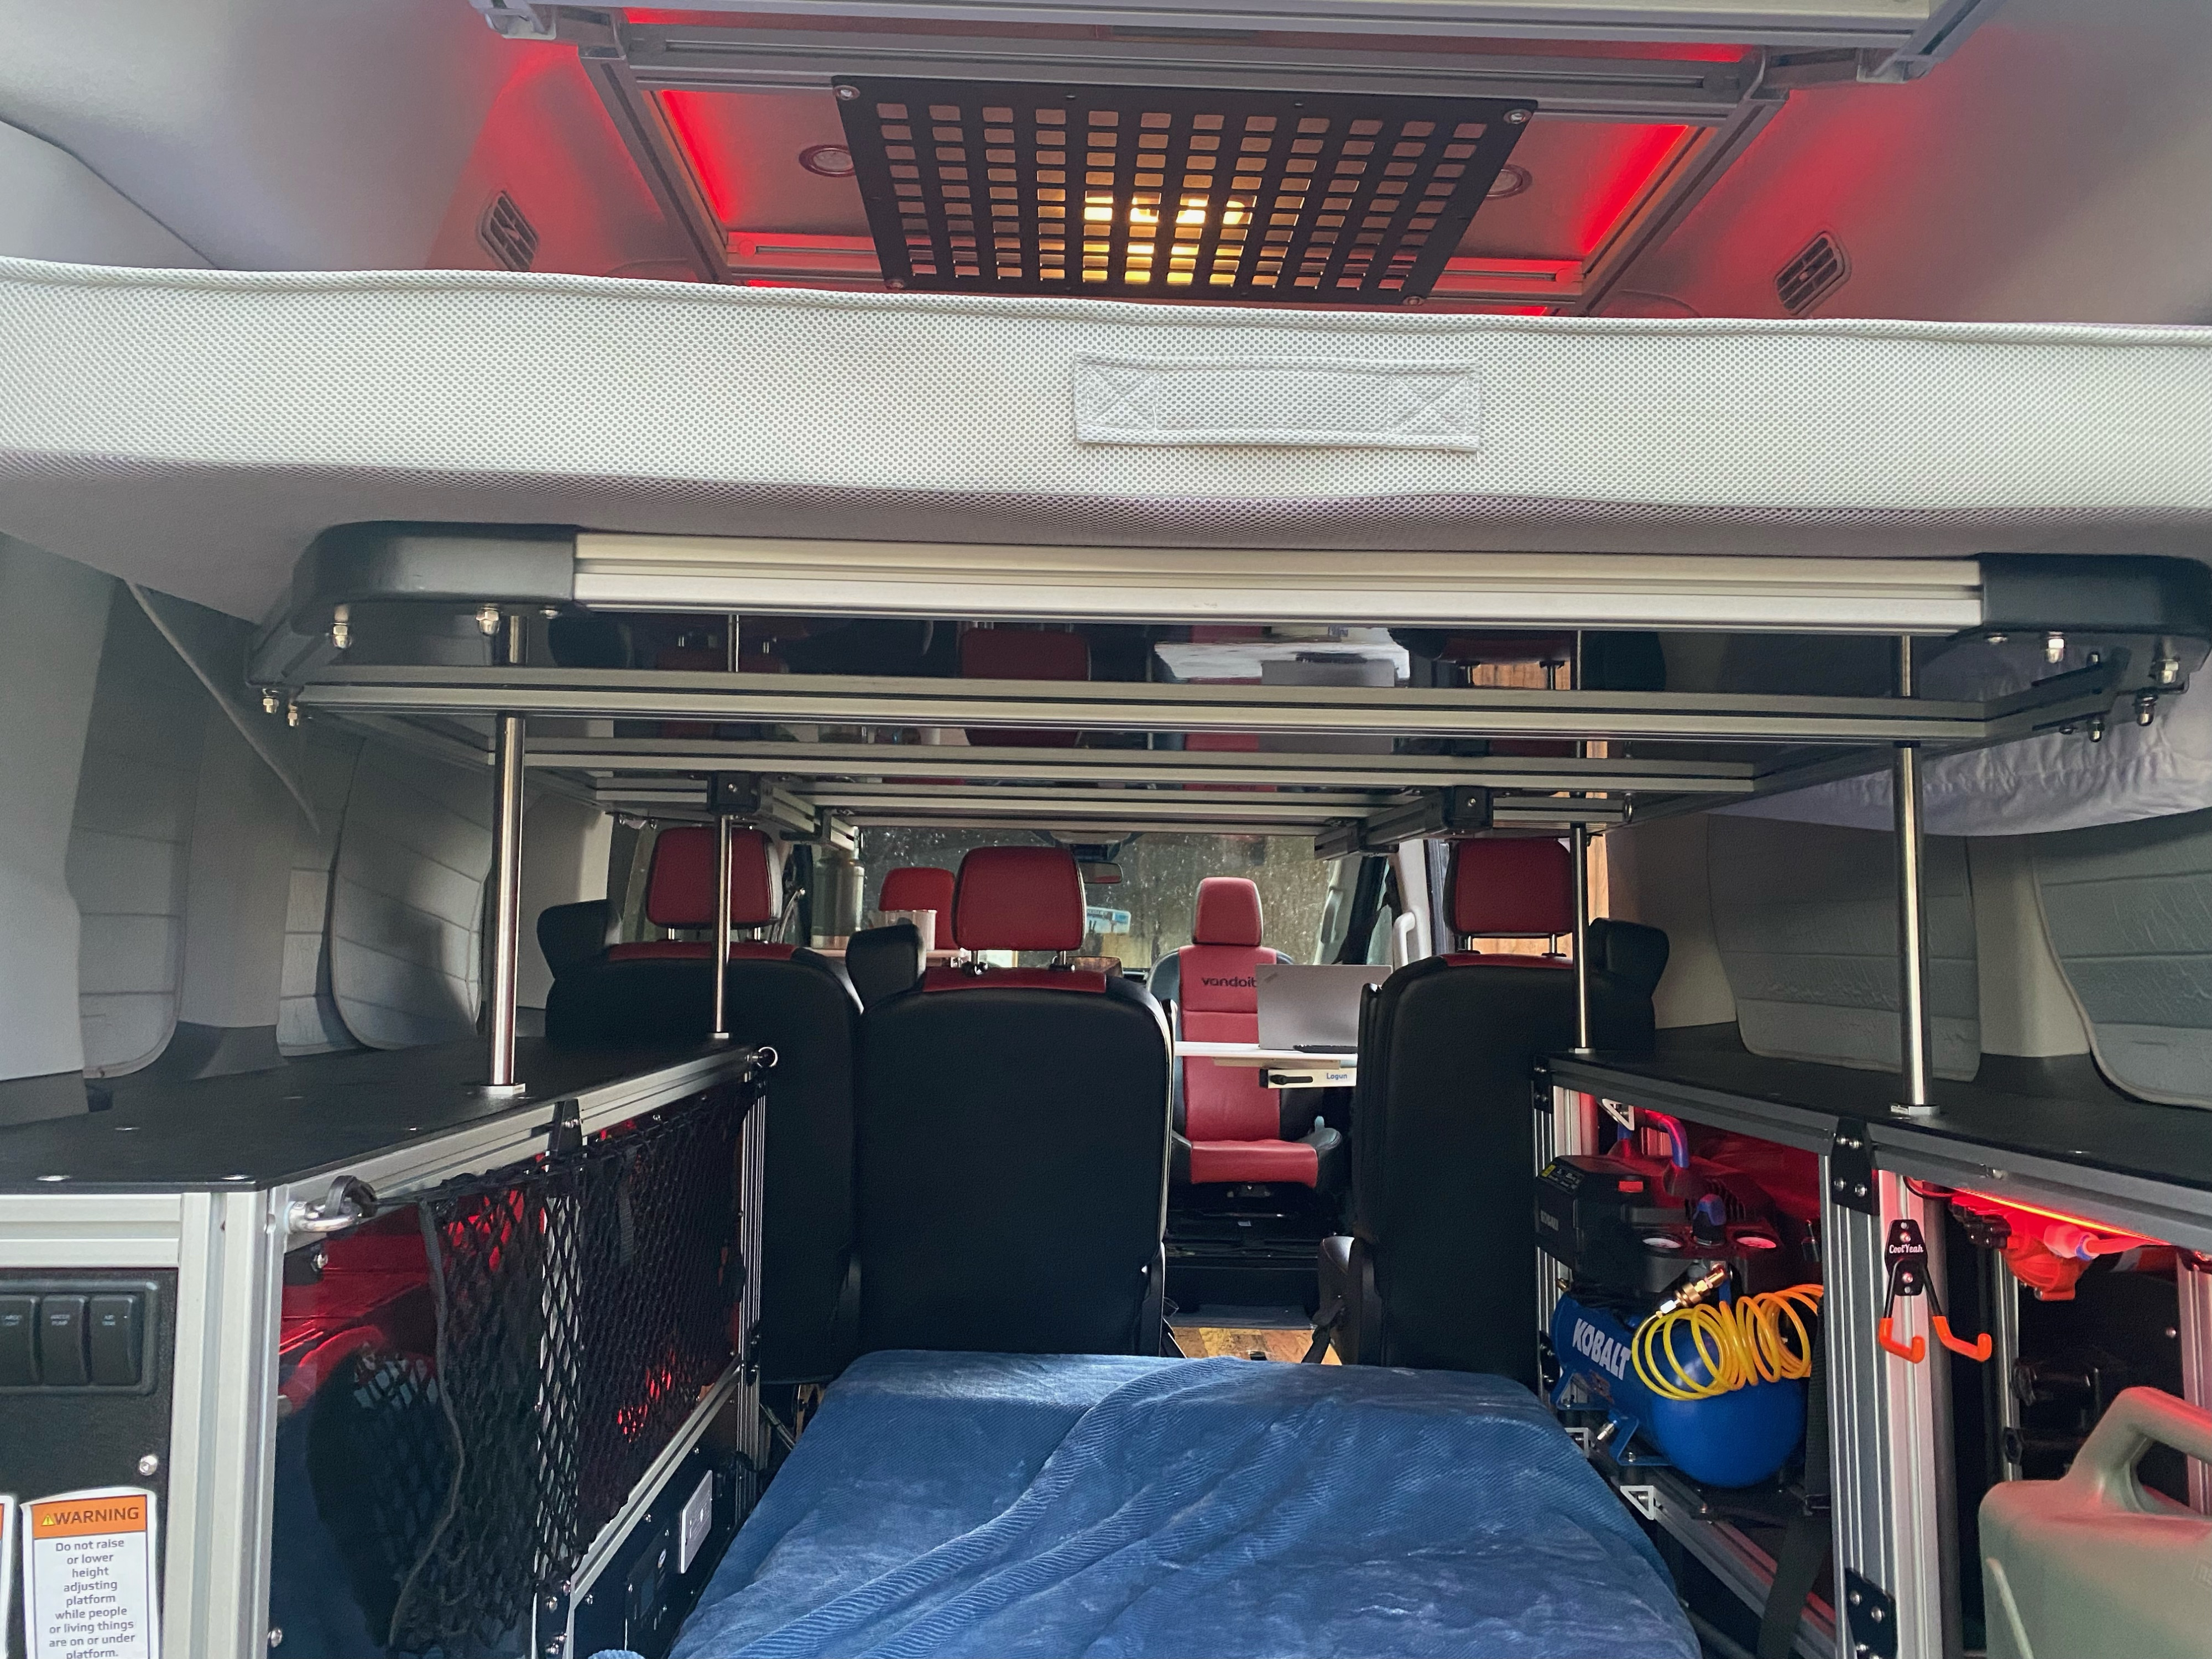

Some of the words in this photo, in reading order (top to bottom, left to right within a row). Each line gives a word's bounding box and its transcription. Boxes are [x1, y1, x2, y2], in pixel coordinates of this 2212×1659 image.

[1201, 977, 1257, 987] vandoit
[1889, 1244, 1924, 1254] CoolYeah
[1572, 1318, 1631, 1380] KOBALT
[54, 1507, 139, 1525] WARNING
[55, 1542, 71, 1552] Do
[74, 1541, 93, 1550] not
[96, 1539, 124, 1549] raise
[81, 1554, 114, 1564] lower
[72, 1566, 109, 1579] height
[64, 1580, 118, 1594] adjusting
[66, 1594, 116, 1608] platform
[55, 1609, 86, 1620] while
[88, 1606, 127, 1620] people
[64, 1623, 95, 1634] living
[97, 1620, 134, 1631] things
[70, 1638, 84, 1646] on
[102, 1633, 135, 1644] under
[66, 1648, 119, 1659] platform.
